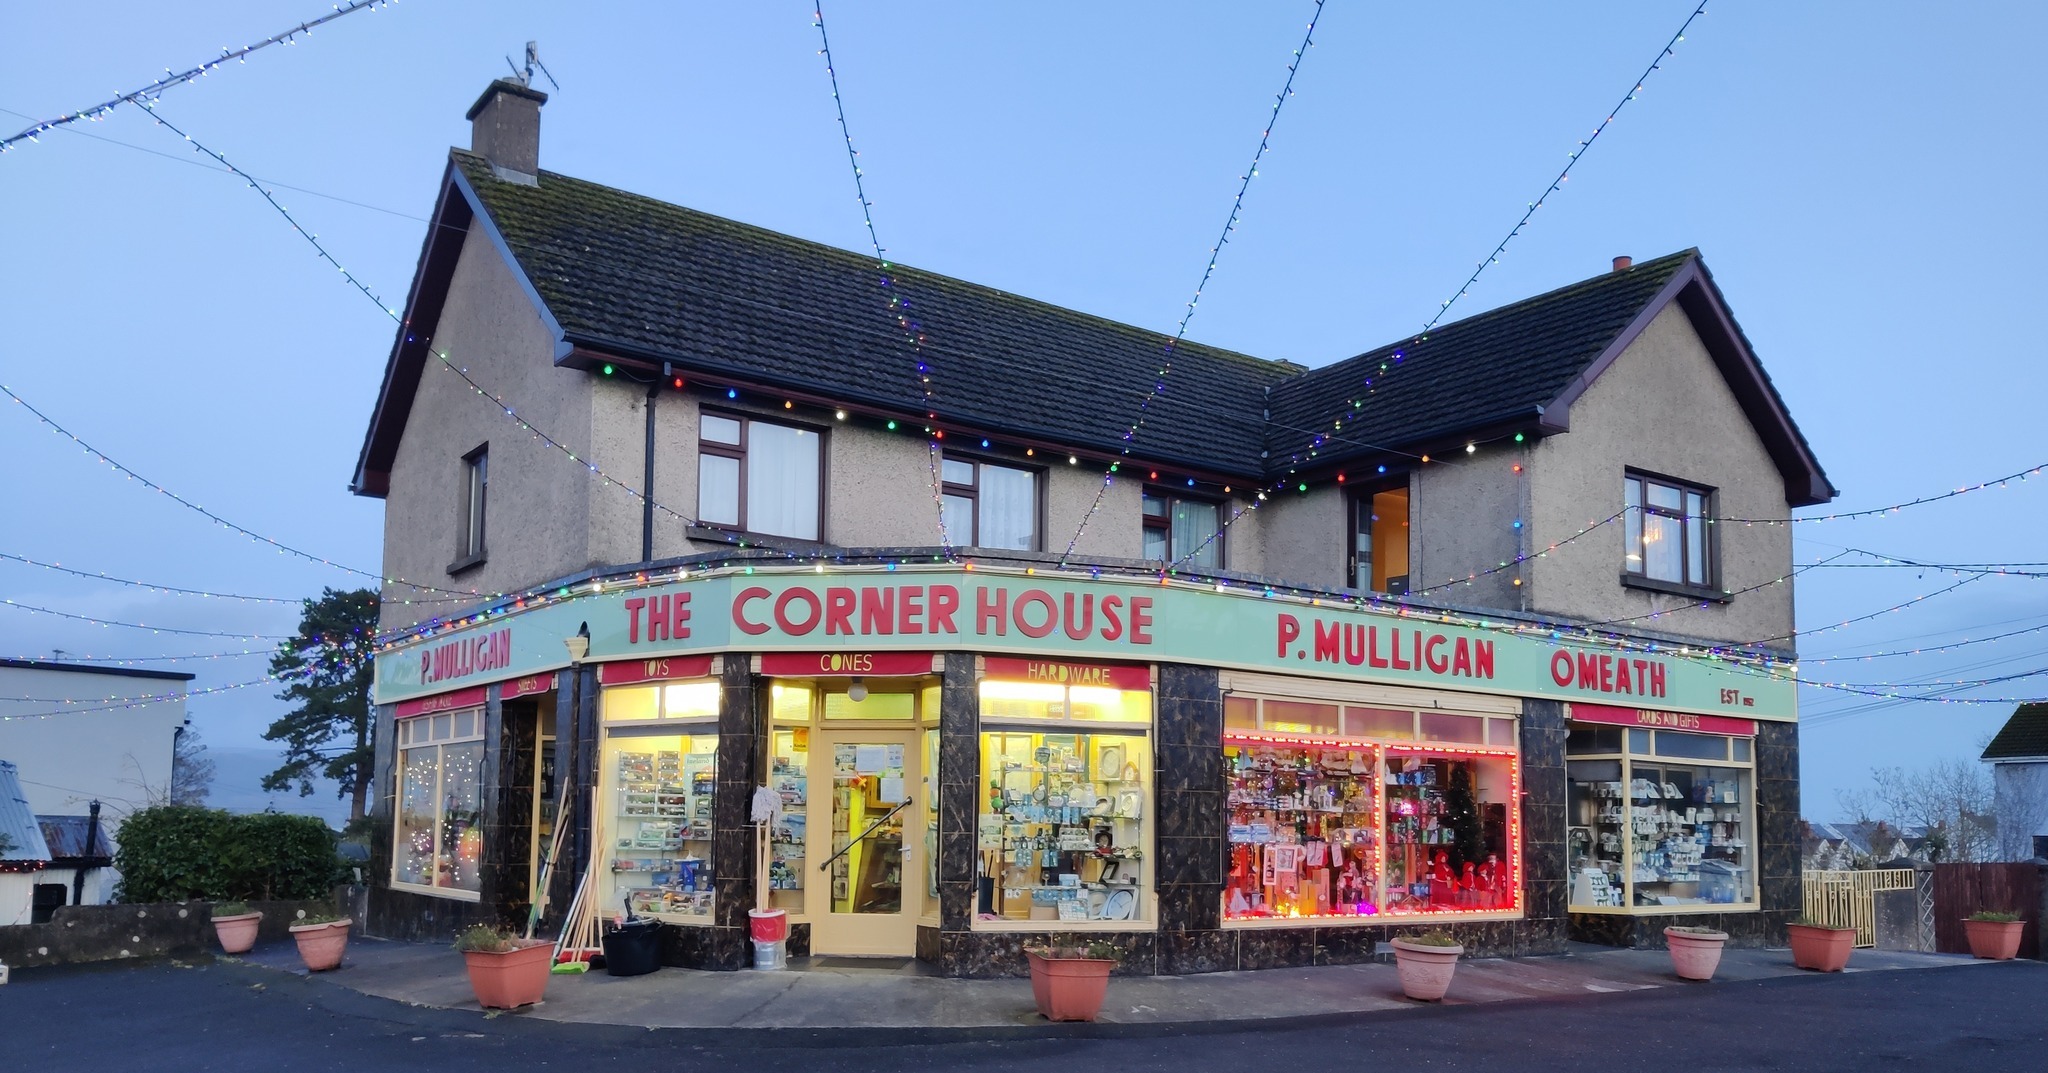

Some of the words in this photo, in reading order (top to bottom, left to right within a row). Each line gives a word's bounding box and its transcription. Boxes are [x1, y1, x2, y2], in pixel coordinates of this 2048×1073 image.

[625, 592, 691, 643] THE
[732, 585, 959, 636] CORNER
[976, 586, 1153, 645] HOUSE
[421, 628, 511, 685] P.MULLIGAN
[820, 654, 873, 672] CONES
[1277, 613, 1494, 679] P.MULLIGAN
[1551, 649, 1666, 697] OMEATH
[644, 659, 669, 676] TOYS
[1027, 662, 1110, 685] HARDWARE
[1720, 688, 1739, 704] EST
[1636, 709, 1661, 725] CARDS
[1663, 711, 1677, 726] AND
[1679, 713, 1699, 728] GIFTS
